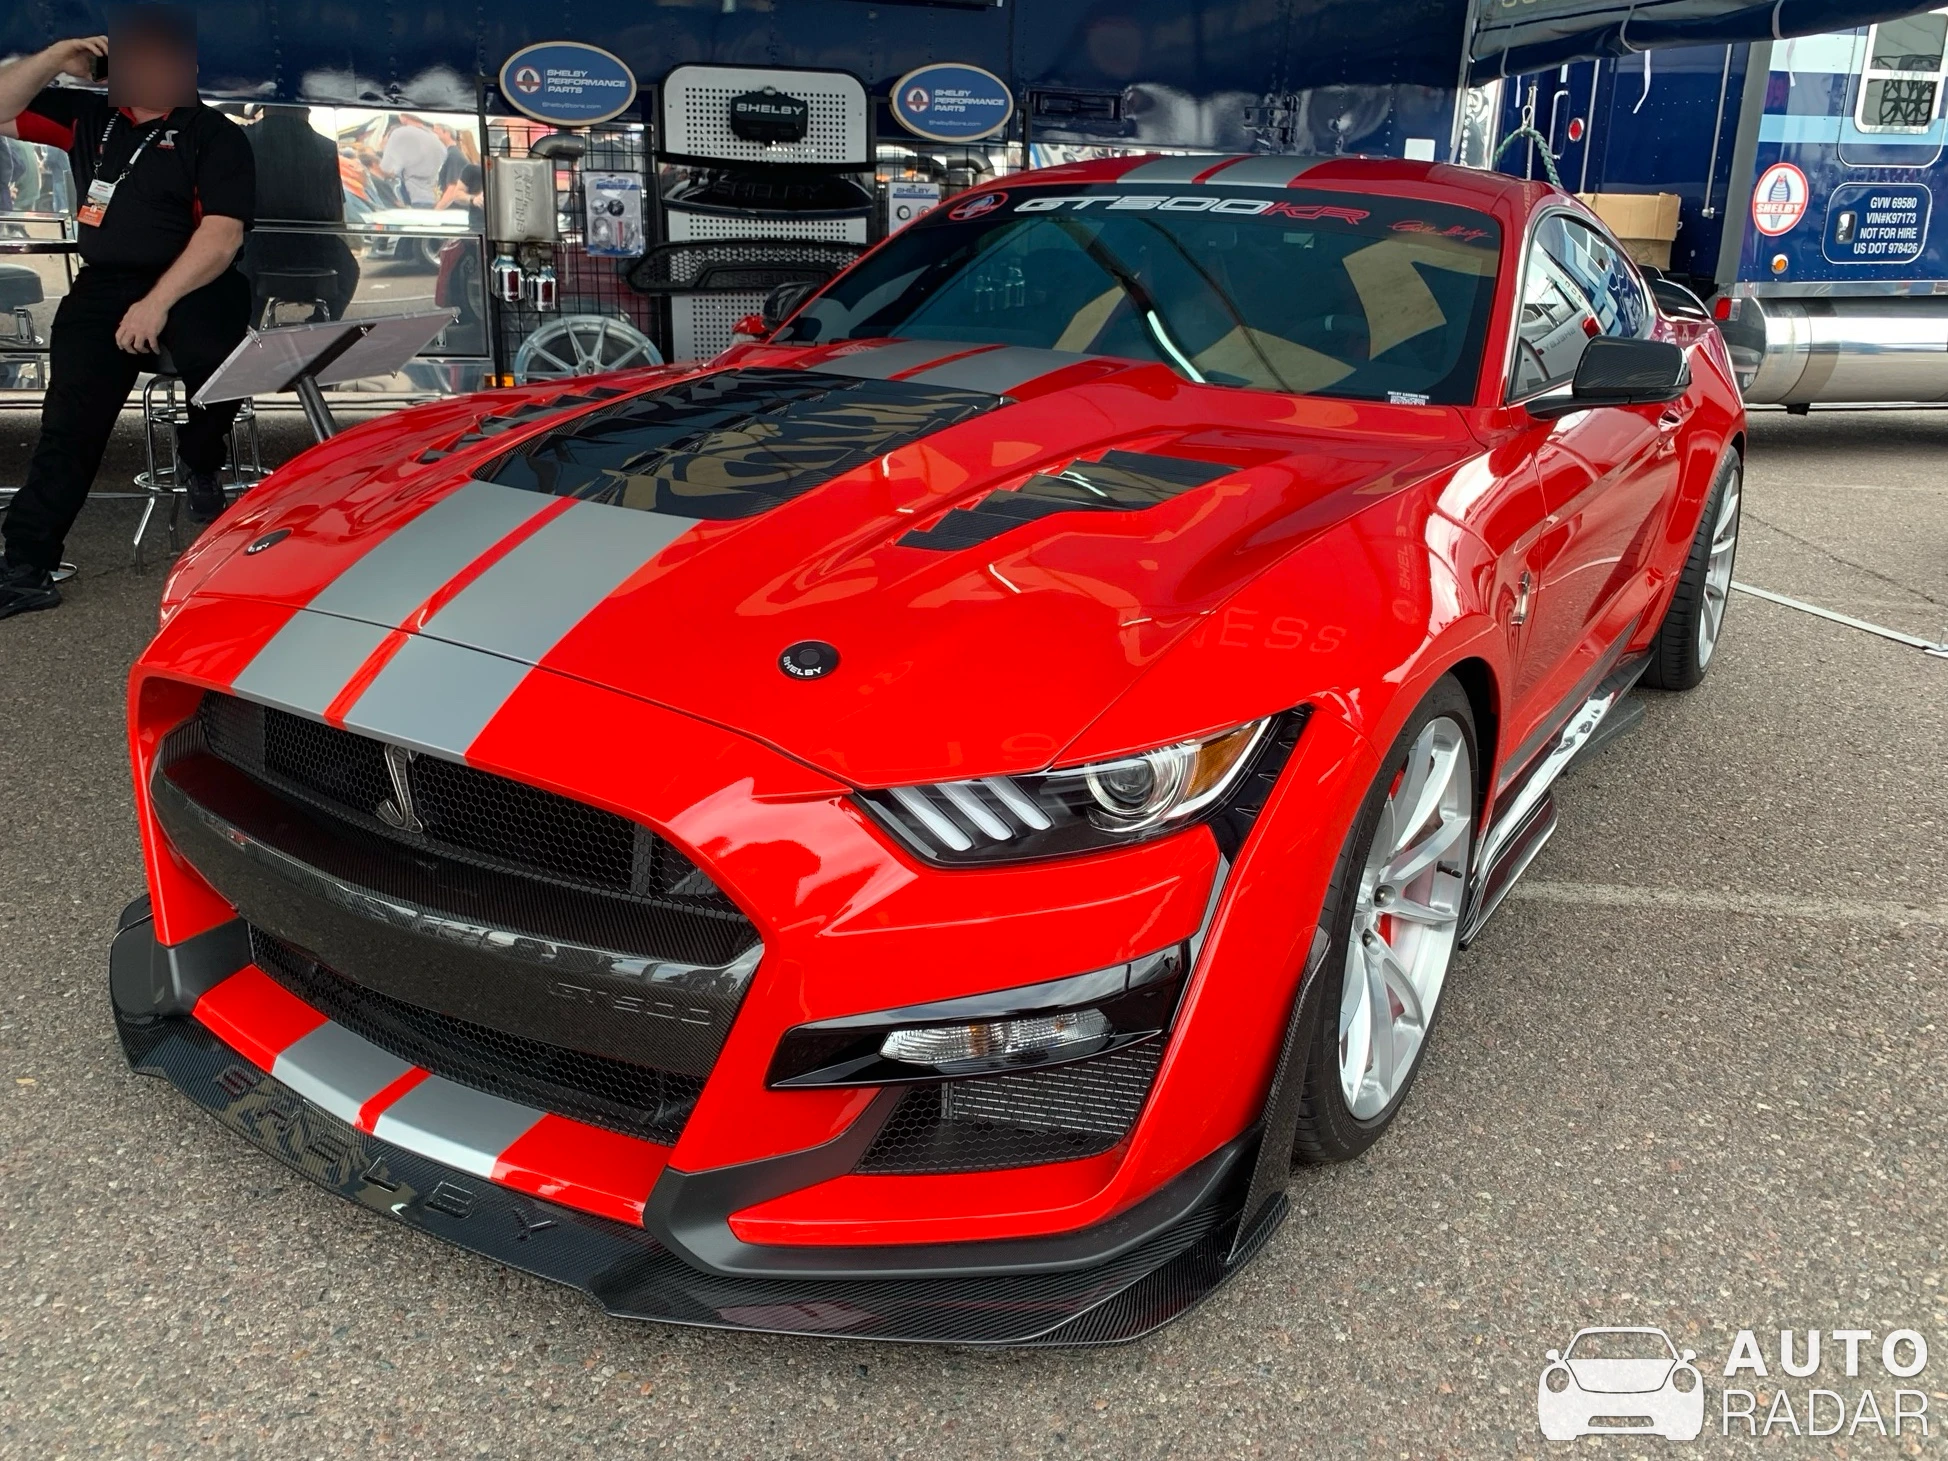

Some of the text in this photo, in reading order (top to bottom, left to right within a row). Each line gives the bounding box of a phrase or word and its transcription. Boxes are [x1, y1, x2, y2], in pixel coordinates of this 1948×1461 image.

[546, 69, 588, 78] SHELBY
[547, 77, 627, 88] PERFORMANCE
[547, 86, 583, 94] PARTS
[934, 89, 972, 97] SHELBY
[541, 101, 602, 110] ShelbyStore.com
[934, 97, 1005, 107] PERFORMANCE
[736, 102, 804, 116] SHELBY
[1755, 202, 1802, 215] SHELBY
[1870, 196, 1918, 209] GVW 69580
[1865, 212, 1917, 225] VIN#K97173
[1859, 227, 1917, 240] NOT FOR HIRE
[1853, 242, 1918, 255] US DOT 978426
[783, 655, 822, 676] SHELBY
[213, 1063, 558, 1241] SHELBY
